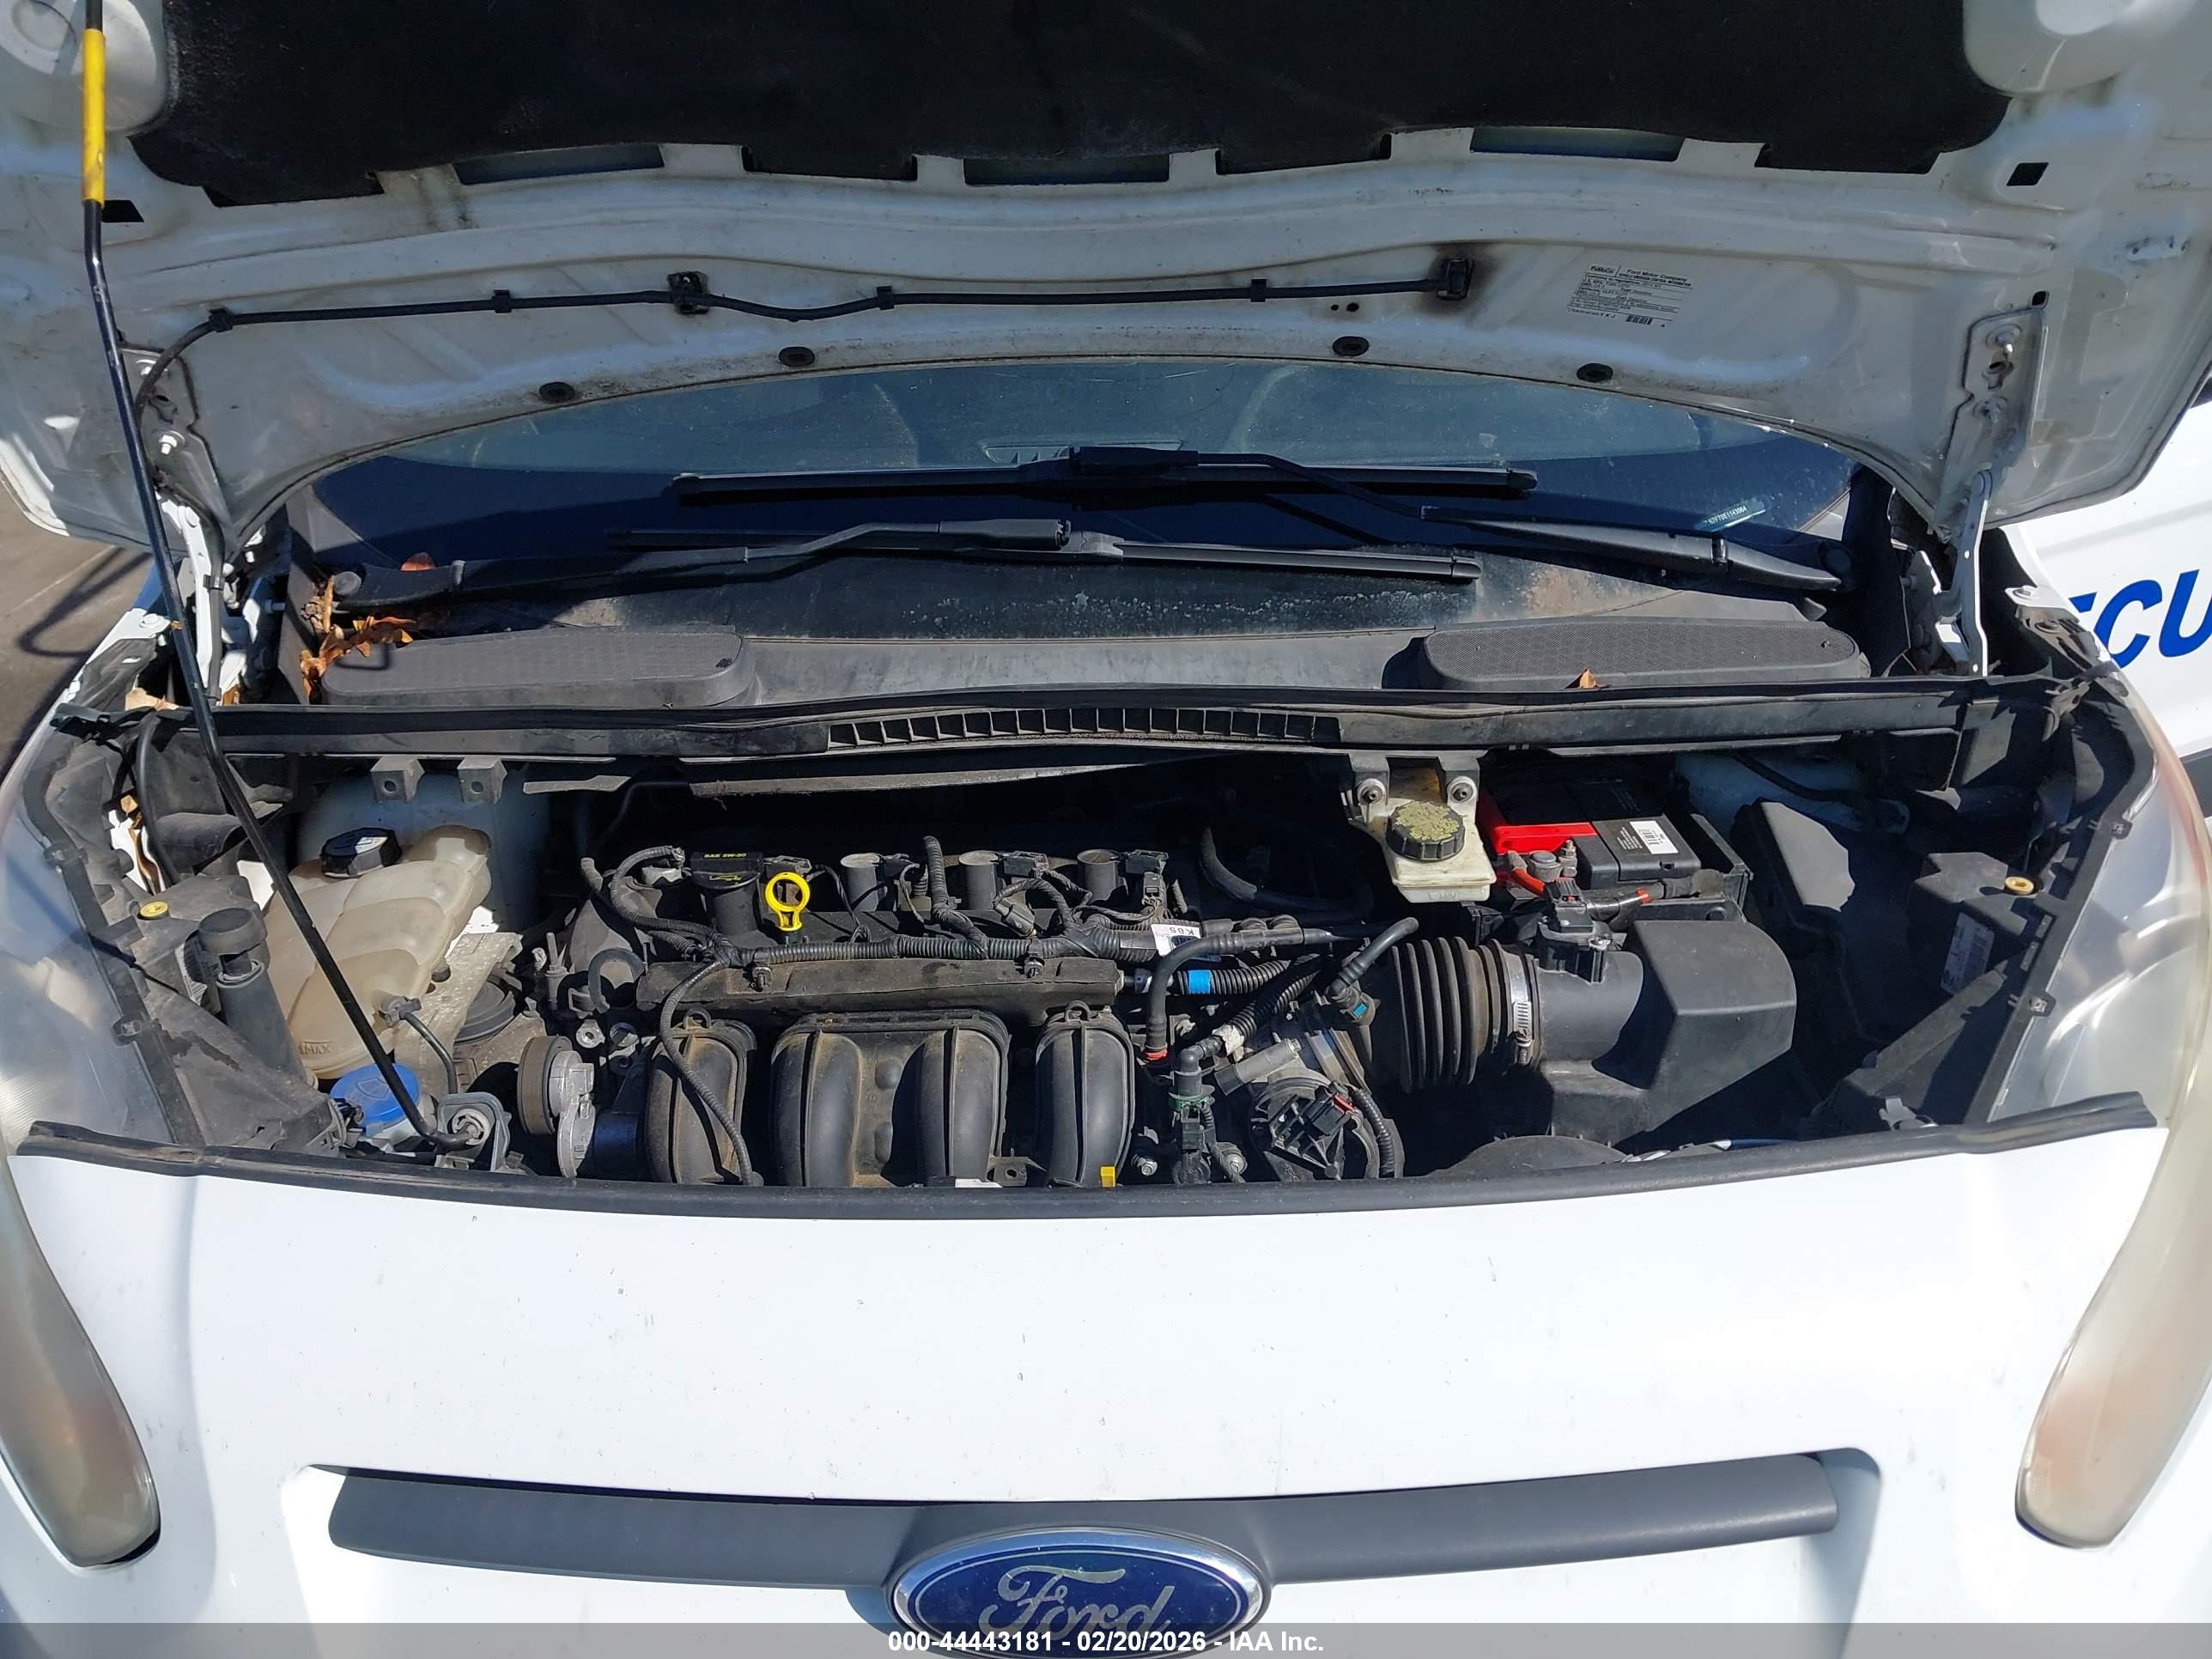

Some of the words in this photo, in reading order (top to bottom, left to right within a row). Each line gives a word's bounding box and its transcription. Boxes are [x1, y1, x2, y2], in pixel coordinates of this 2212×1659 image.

[1660, 274, 1688, 283] Company
[2068, 568, 2212, 669] CU
[1169, 927, 1194, 936] K85
[305, 1043, 331, 1054] MAX
[978, 1565, 1176, 1640] Ford
